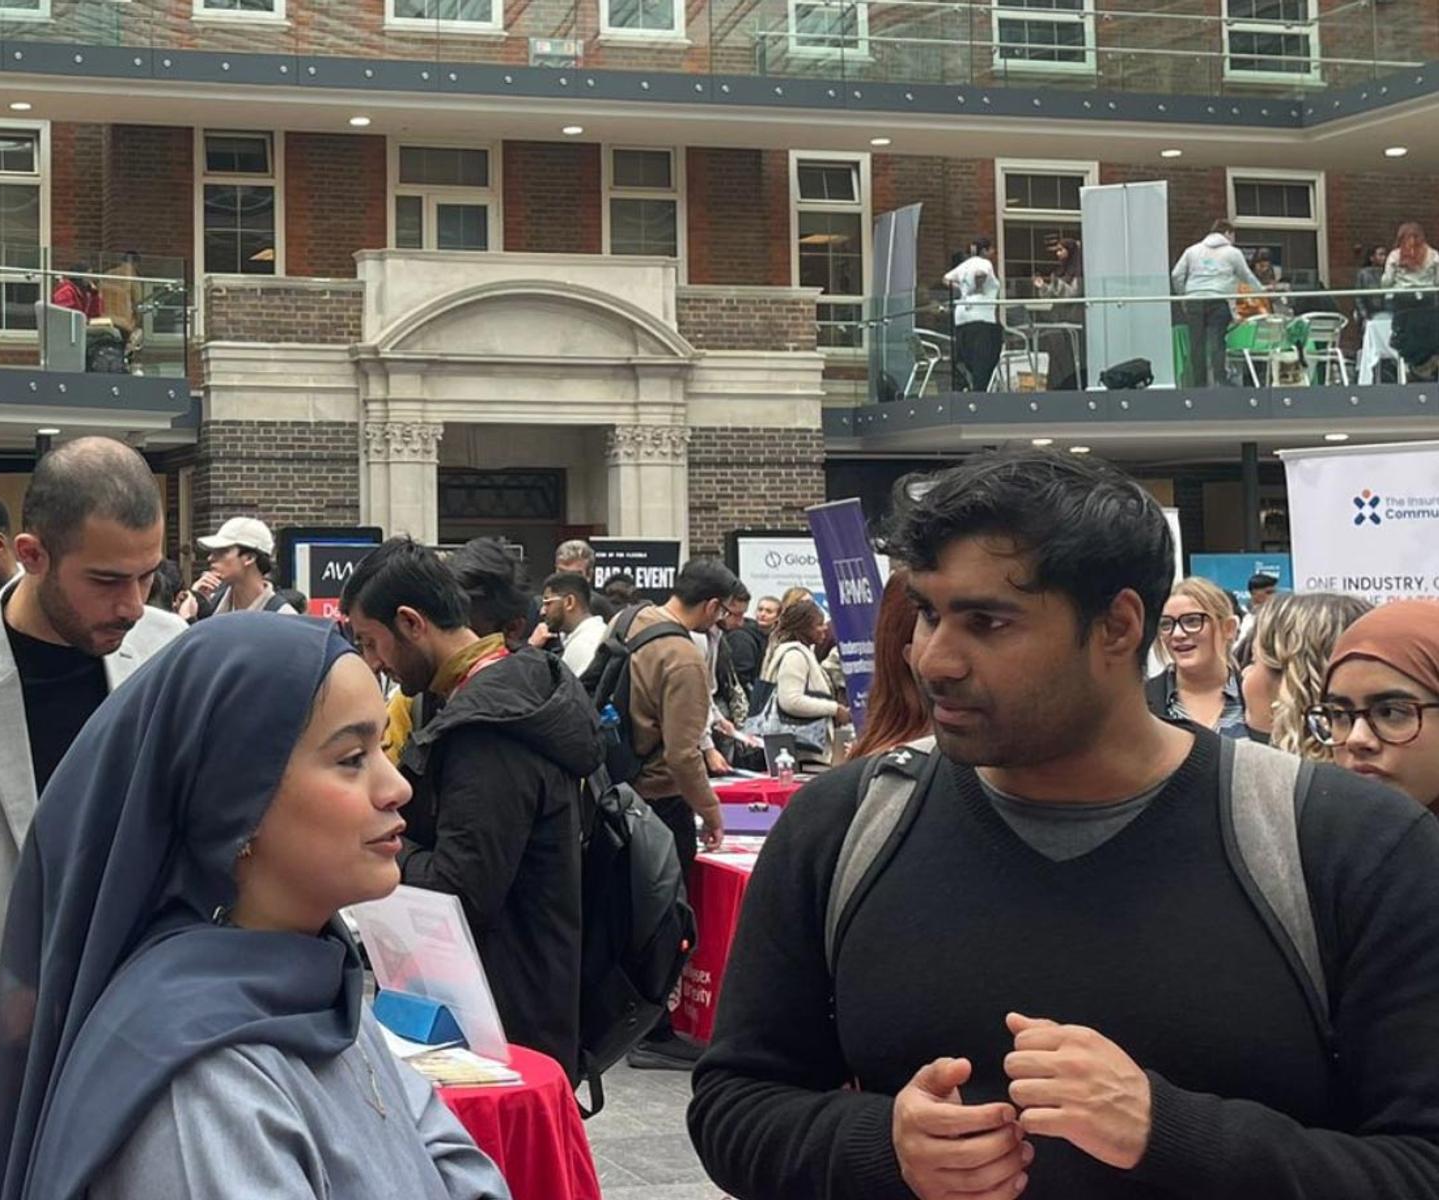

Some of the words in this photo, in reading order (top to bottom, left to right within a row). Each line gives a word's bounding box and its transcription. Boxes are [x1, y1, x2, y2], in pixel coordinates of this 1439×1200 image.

[1407, 497, 1439, 507] Insur
[1385, 508, 1439, 521] Commu
[636, 566, 676, 589] EVENT
[1306, 576, 1338, 589] ONE
[1342, 576, 1428, 592] INDUSTRY,
